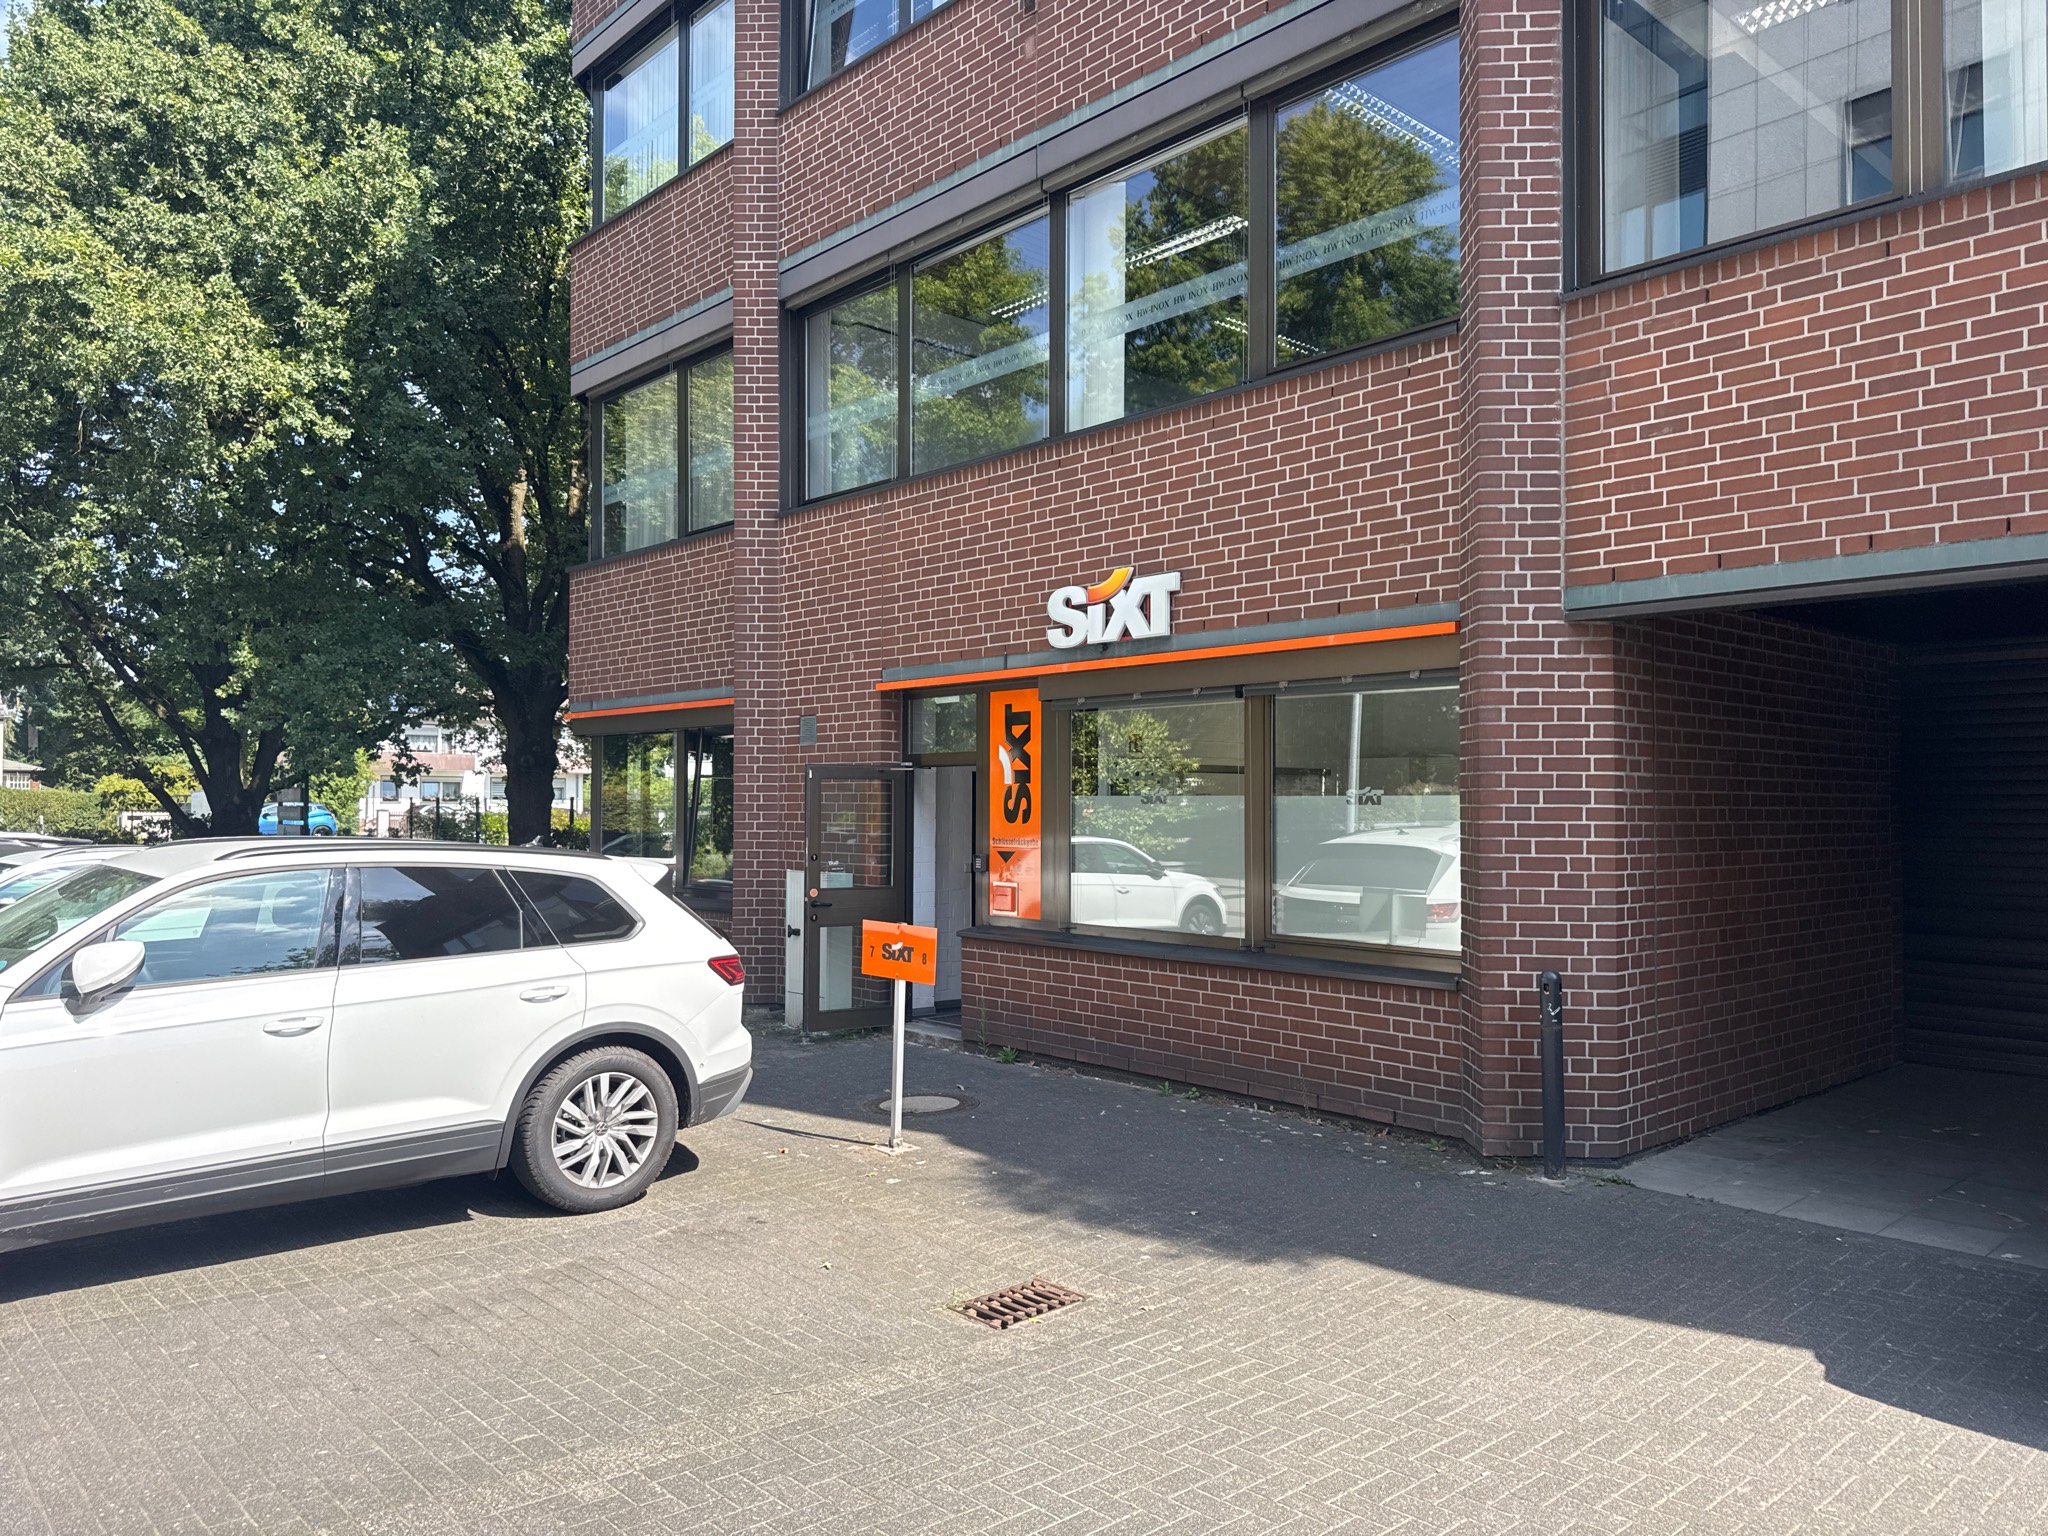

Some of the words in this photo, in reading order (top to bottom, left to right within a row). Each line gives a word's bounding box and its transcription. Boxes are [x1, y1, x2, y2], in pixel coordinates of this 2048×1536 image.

[1279, 248, 1318, 270] HW-INOX
[1323, 233, 1365, 255] HW-INOX
[1370, 214, 1416, 239] HW-INOX
[1420, 199, 1460, 221] HW-INO
[869, 945, 875, 958] 7
[921, 952, 928, 965] 8
